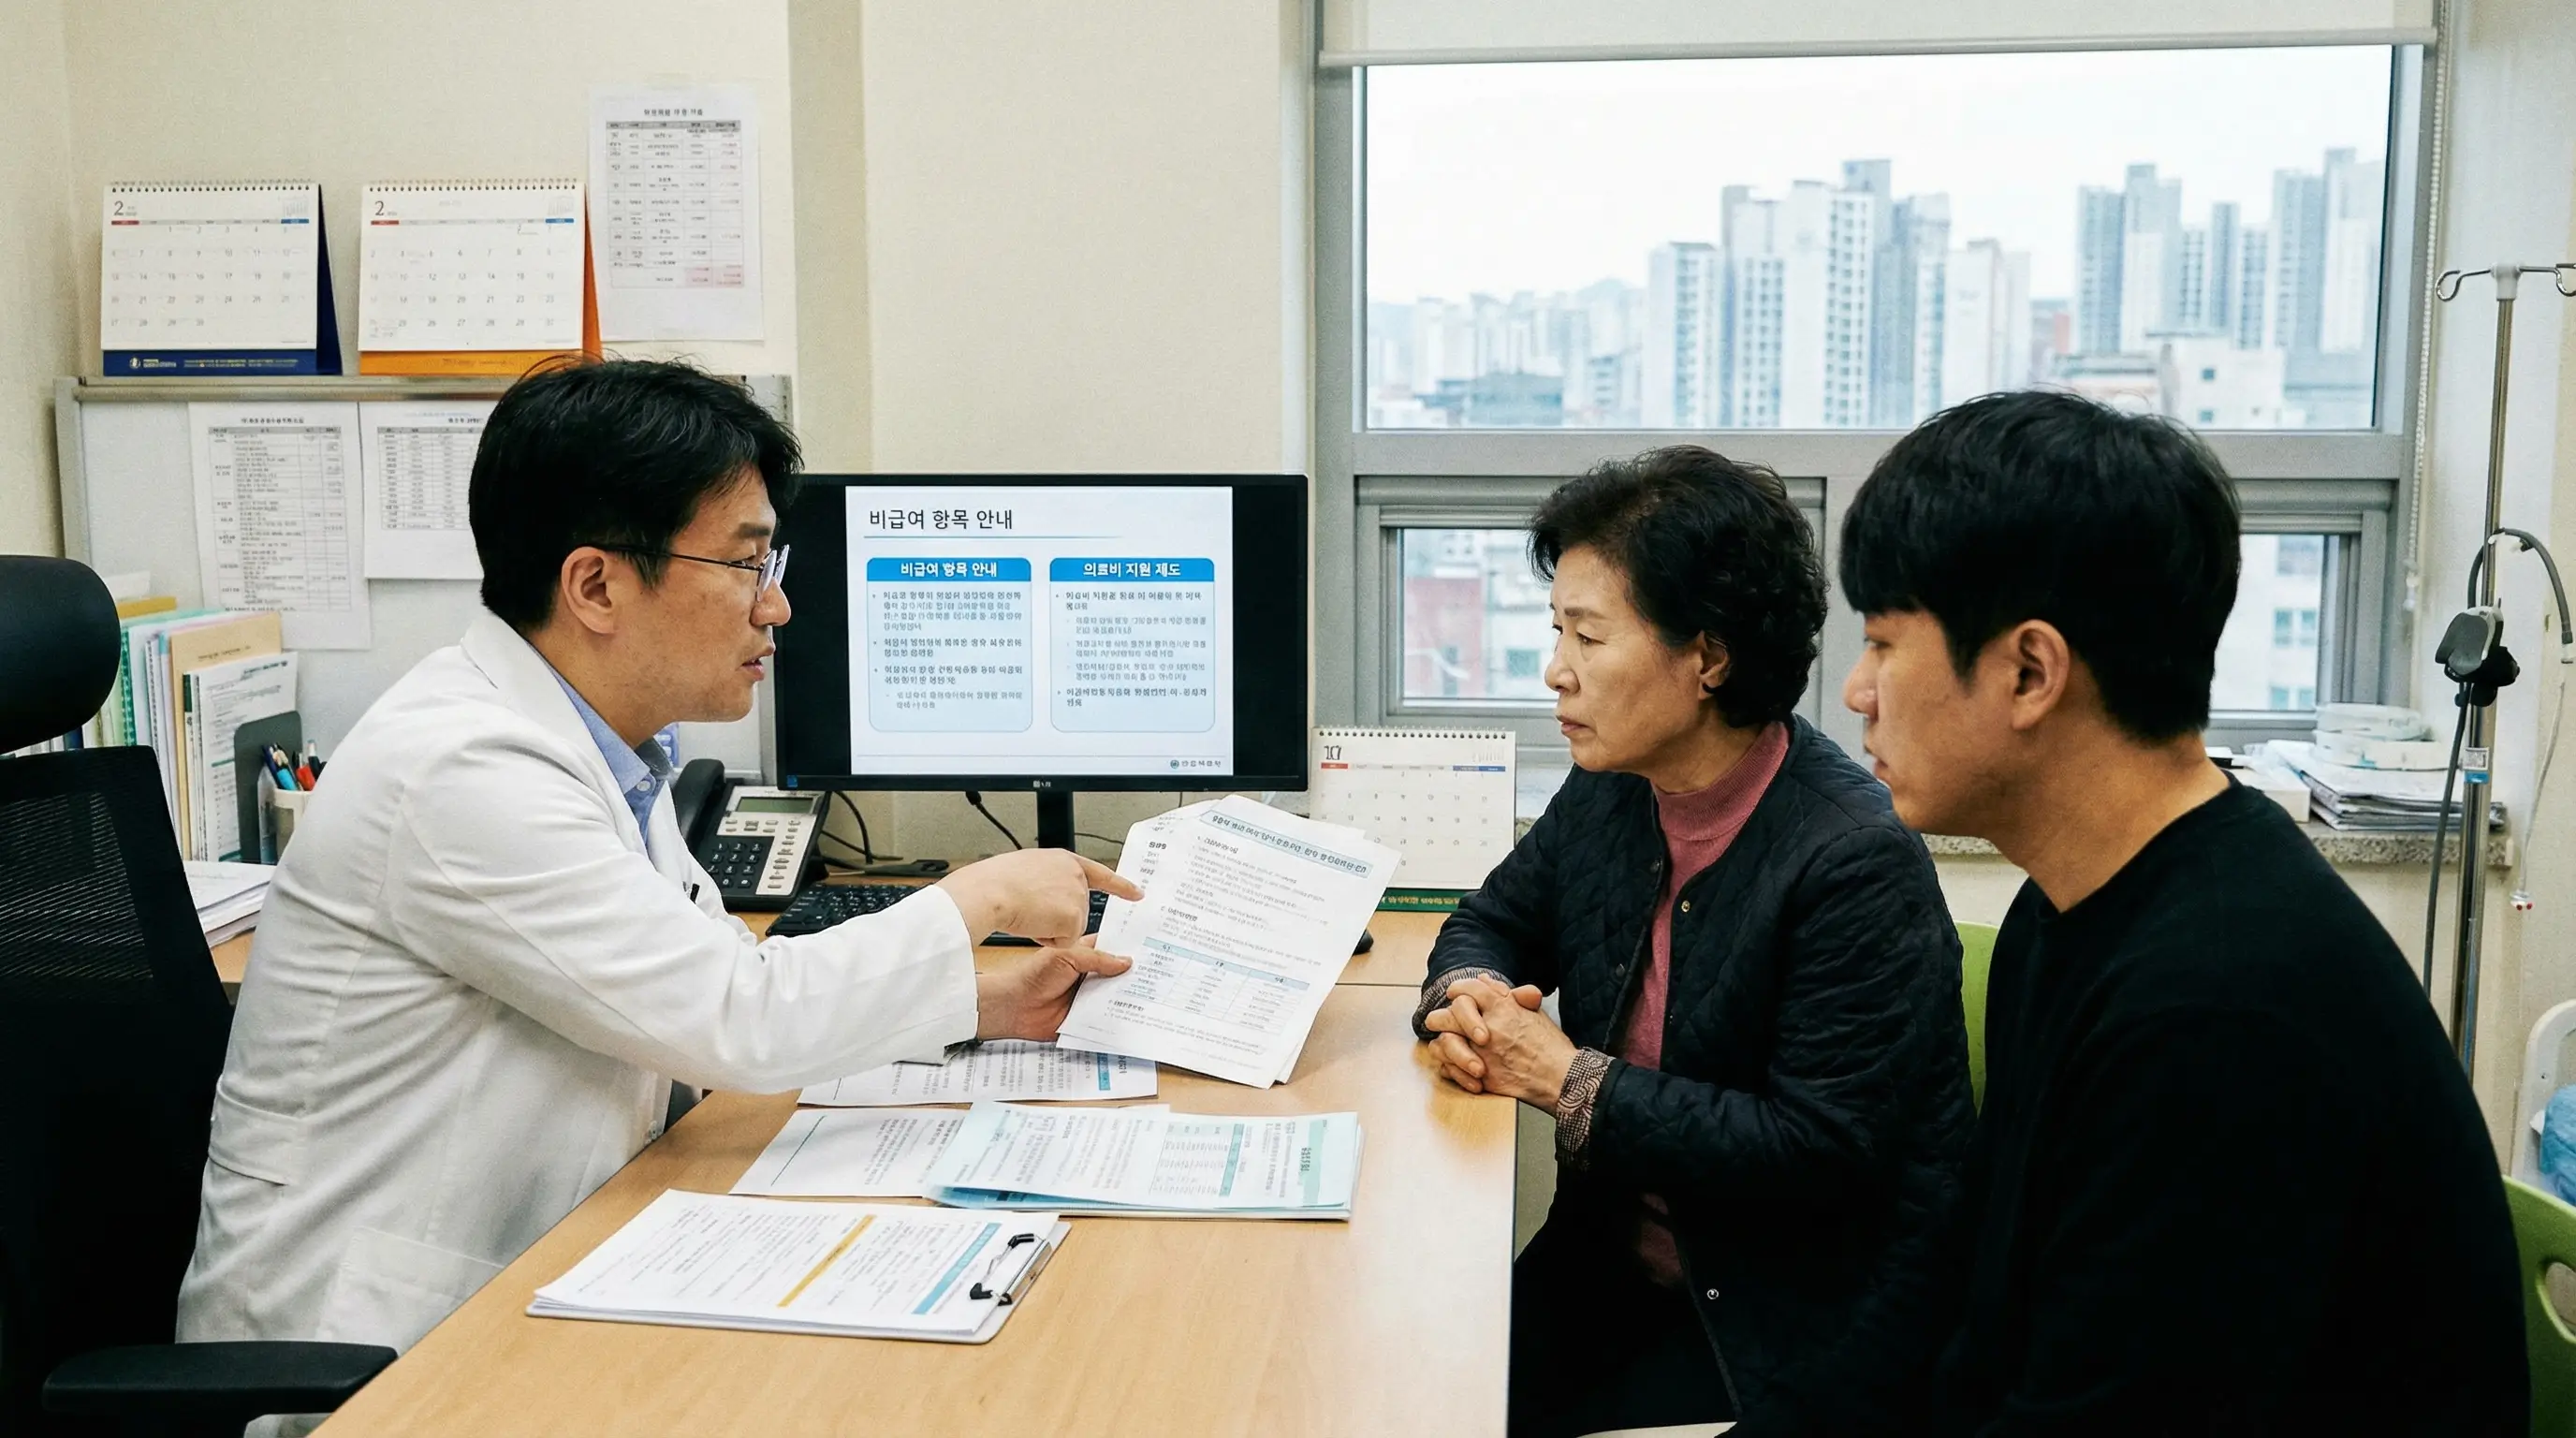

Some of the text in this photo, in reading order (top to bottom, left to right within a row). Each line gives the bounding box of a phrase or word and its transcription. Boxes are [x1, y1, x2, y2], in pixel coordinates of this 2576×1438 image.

[373, 199, 385, 216] 2
[870, 509, 1013, 530] 비급여 항목 안내
[900, 562, 939, 578] 비급여
[972, 562, 997, 578] 안내
[1083, 562, 1181, 578] 의료비 지원 제도
